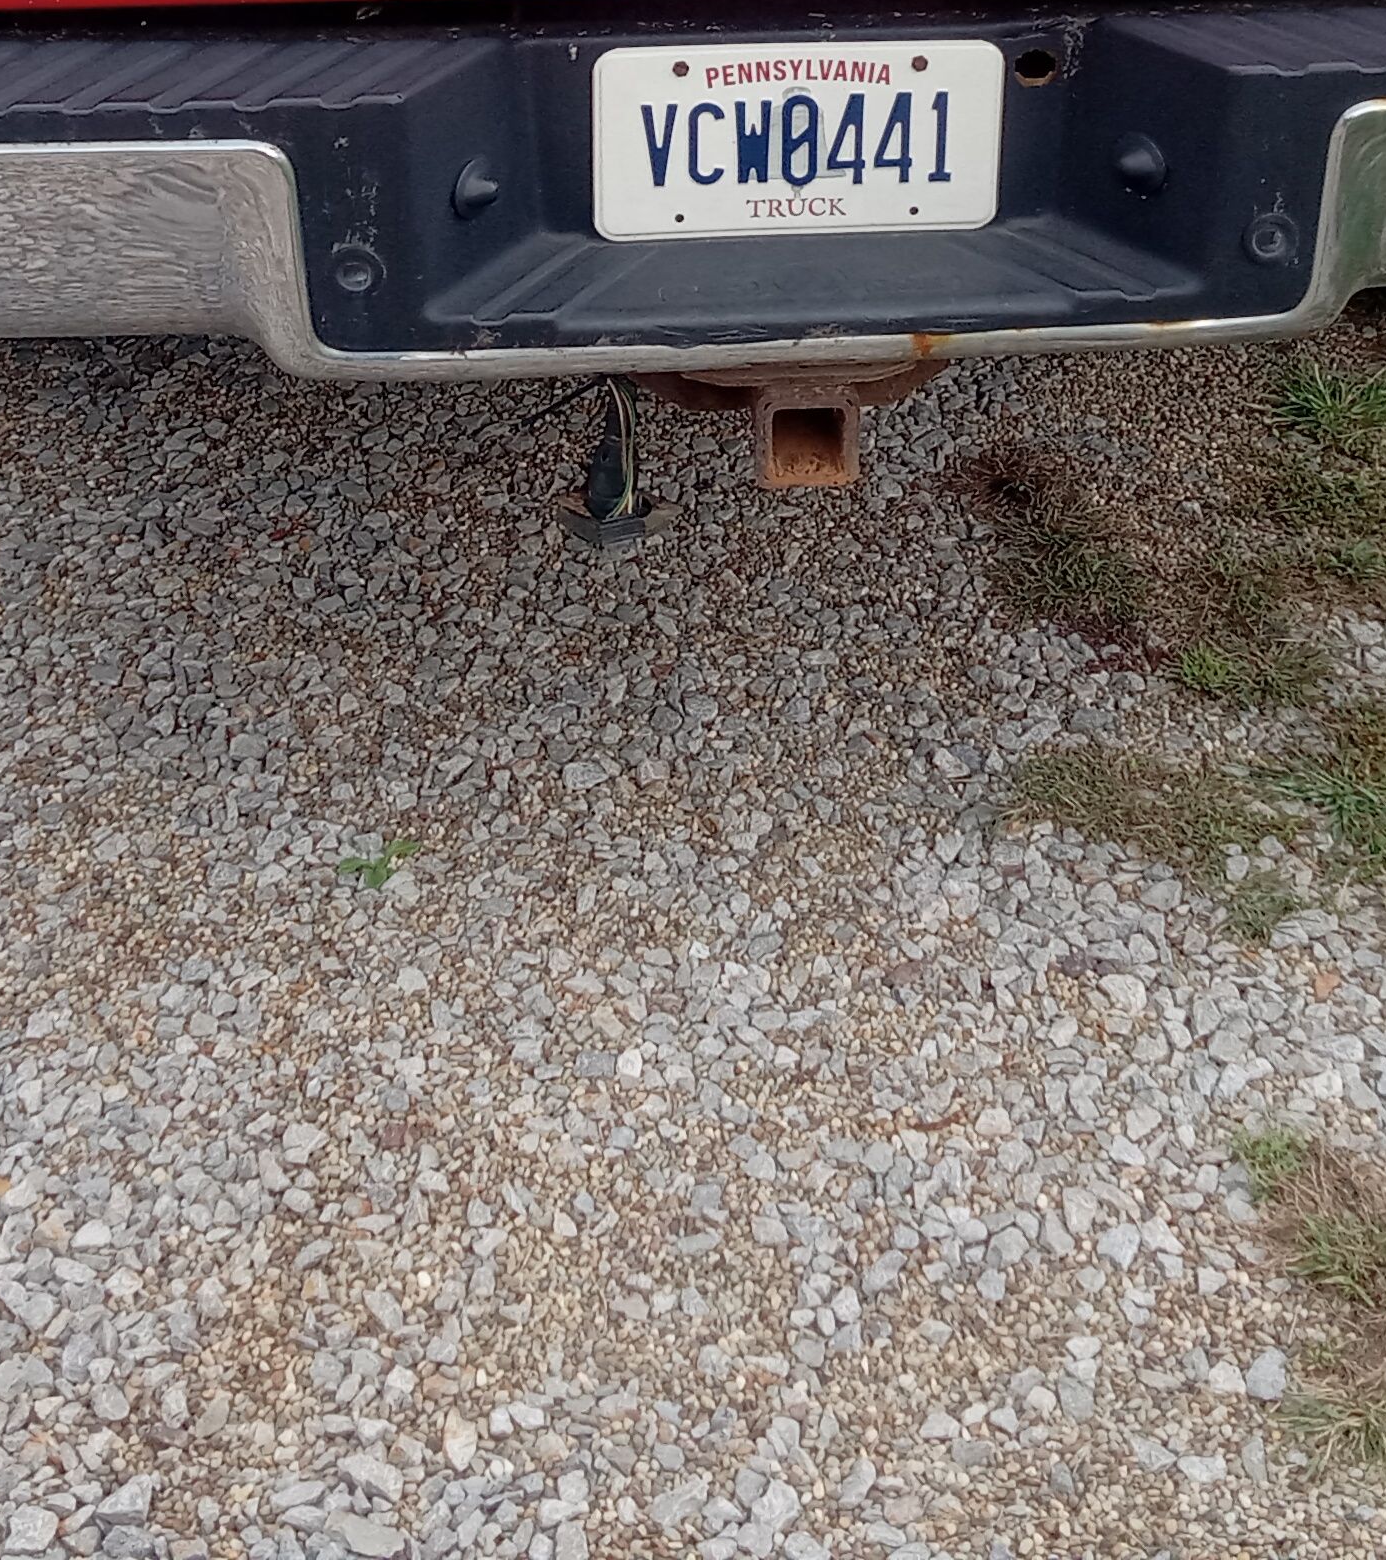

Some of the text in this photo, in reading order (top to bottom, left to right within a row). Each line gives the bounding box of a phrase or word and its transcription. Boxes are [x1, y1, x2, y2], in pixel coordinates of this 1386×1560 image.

[705, 59, 891, 88] PENNSYLVANIA
[640, 91, 951, 187] VCW0441
[746, 197, 846, 218] TRUCK
